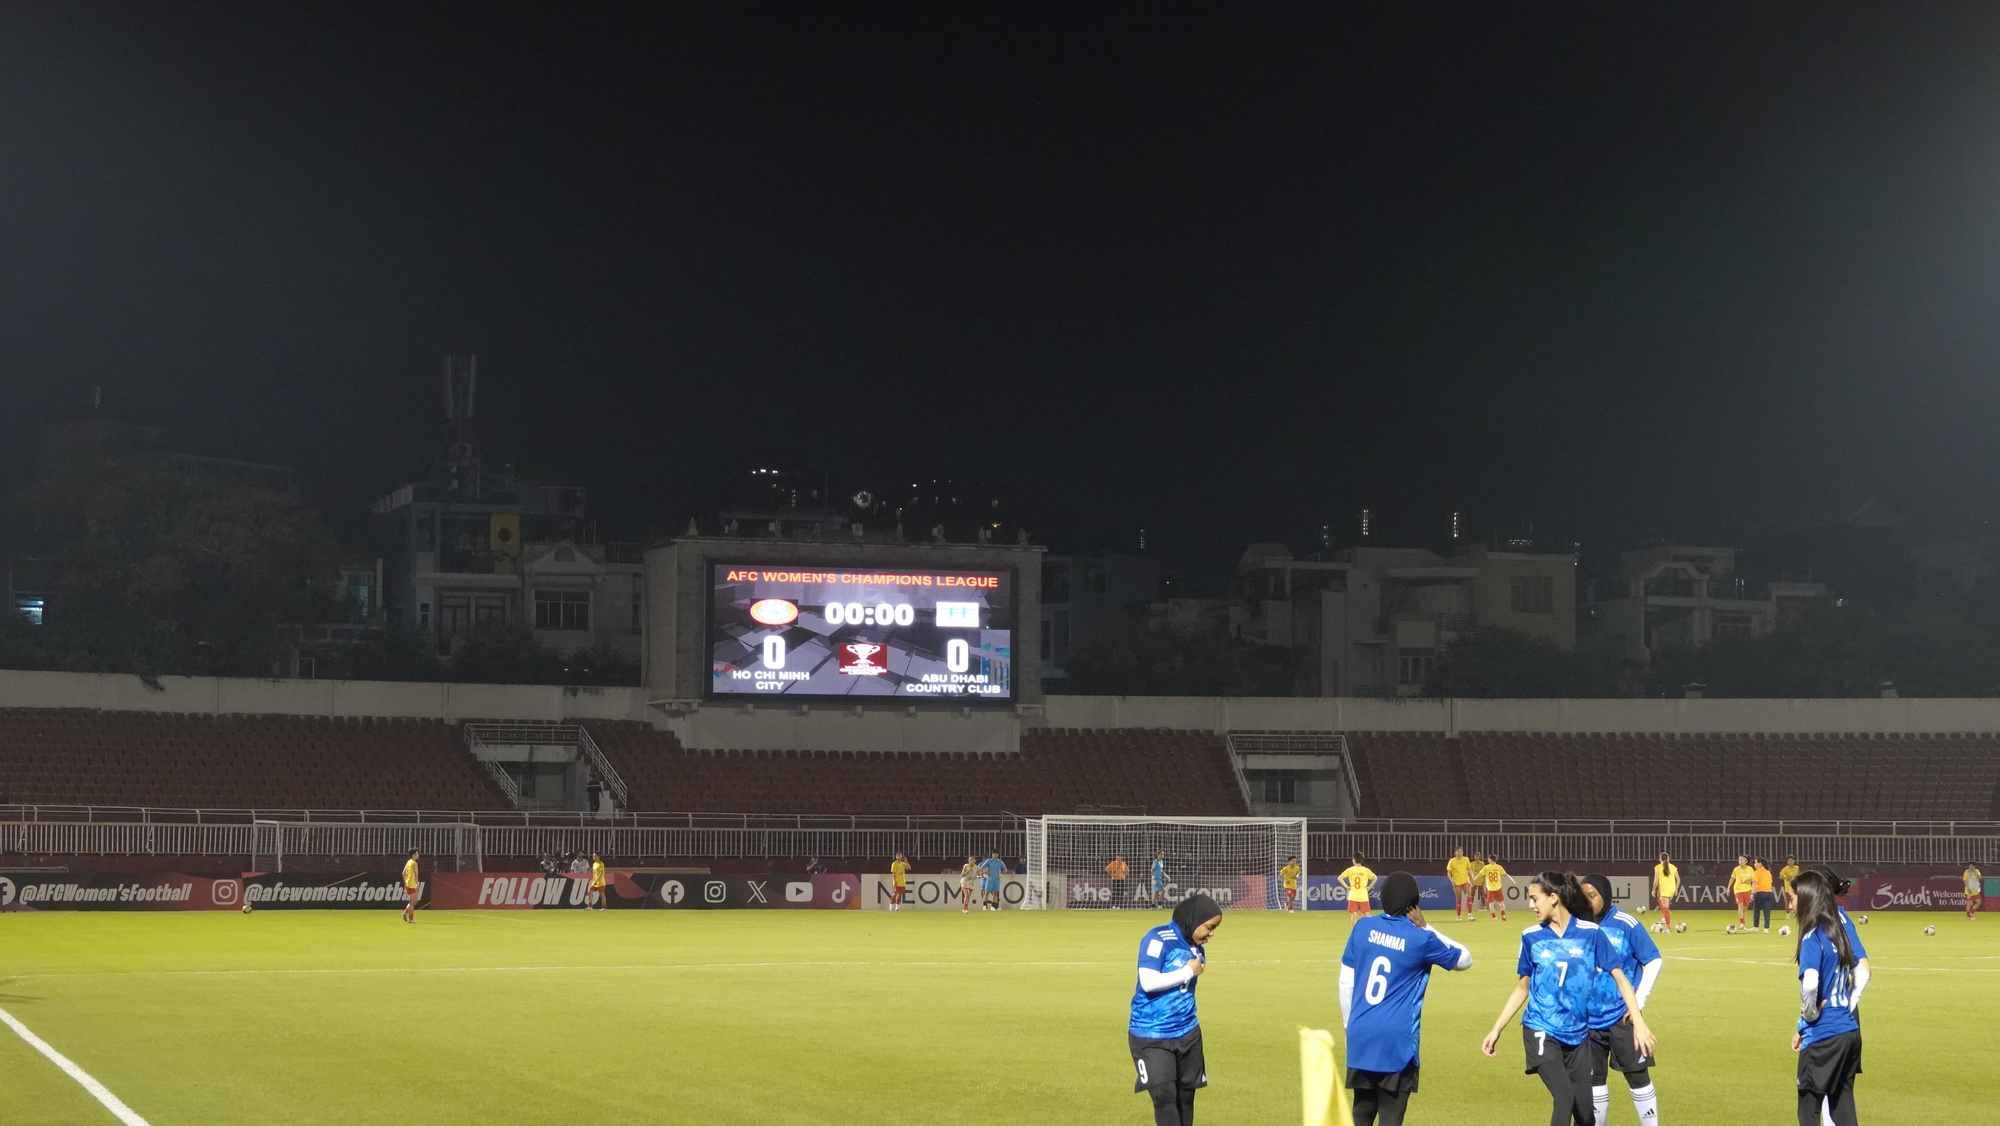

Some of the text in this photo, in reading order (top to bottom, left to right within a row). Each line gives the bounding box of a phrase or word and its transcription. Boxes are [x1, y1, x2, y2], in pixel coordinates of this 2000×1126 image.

[727, 571, 998, 588] AFC WOMEN'S CHAMPIONS LEAGUE
[825, 602, 914, 626] 00:00
[763, 635, 786, 670] 0
[947, 638, 969, 673] 0
[732, 670, 810, 681] HO CHI MINH
[755, 681, 784, 690] CITY
[921, 673, 989, 684] ABU DHABI
[905, 683, 1001, 694] COUNTRY CLUB
[1354, 876, 1361, 890] 8
[1488, 871, 1499, 882] 88
[19, 882, 193, 905] @AFCWomen'sFootball
[243, 881, 426, 906] @afcwomensfootbal
[478, 877, 567, 905] FOLLOW
[1669, 885, 1728, 903] ATAR
[1368, 929, 1406, 952] SHAMMA
[1365, 955, 1392, 1006] 6
[1555, 961, 1568, 988] 7
[1534, 1031, 1546, 1056] 7
[1137, 1058, 1149, 1085] 9
